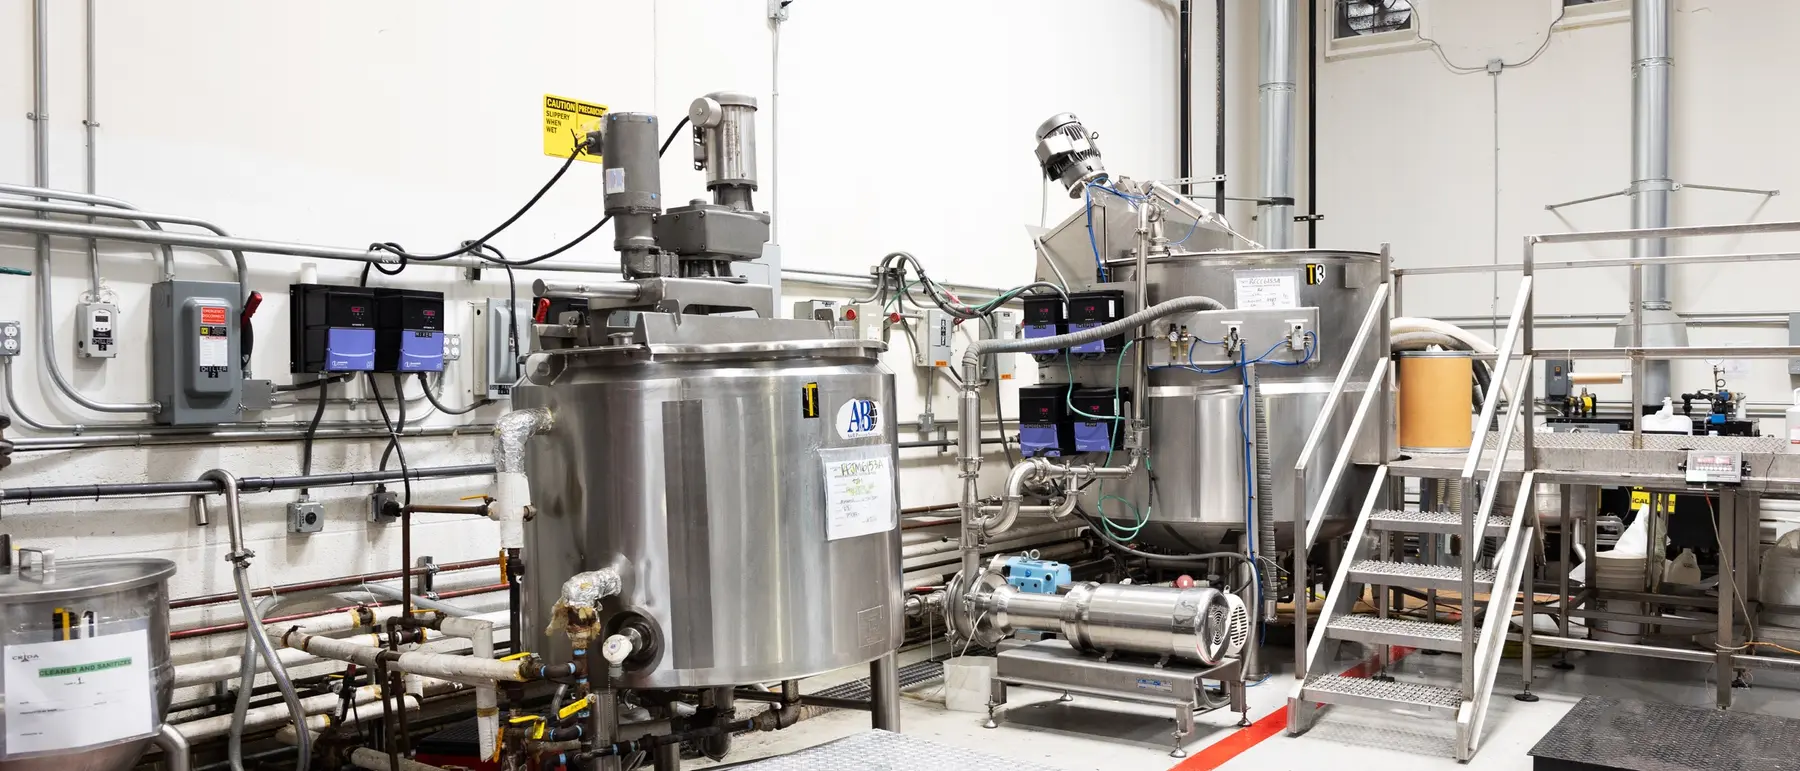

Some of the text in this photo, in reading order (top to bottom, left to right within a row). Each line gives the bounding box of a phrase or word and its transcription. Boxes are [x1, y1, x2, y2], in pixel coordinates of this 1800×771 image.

[547, 98, 576, 112] CAUTION
[546, 110, 570, 121] SLIPPERY
[546, 118, 561, 126] WHEN
[546, 126, 557, 134] WET
[1306, 264, 1324, 284] T3
[803, 383, 817, 416] T
[39, 667, 77, 677] CLEANED
[79, 664, 95, 672] AND
